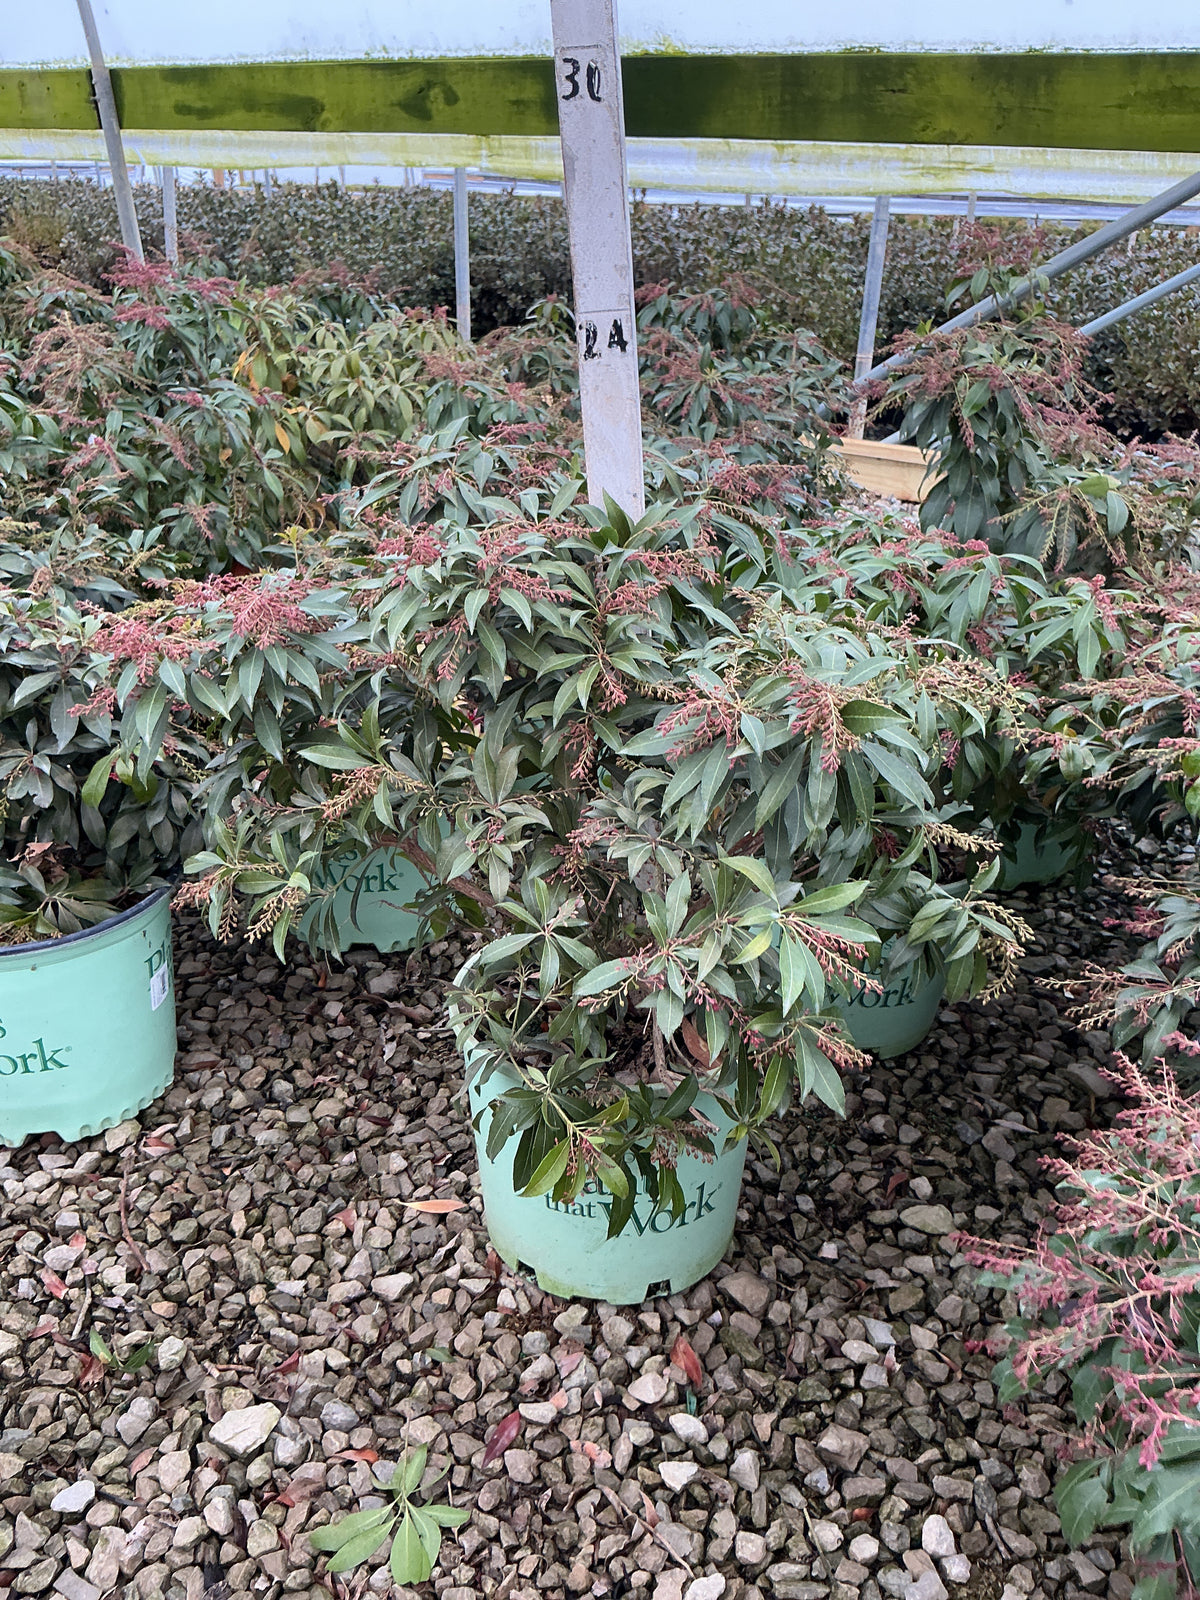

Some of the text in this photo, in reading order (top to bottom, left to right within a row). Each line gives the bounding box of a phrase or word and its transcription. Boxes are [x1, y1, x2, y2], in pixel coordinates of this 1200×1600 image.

[561, 57, 602, 101] 30
[314, 863, 400, 893] Work
[597, 1181, 719, 1238] Work
